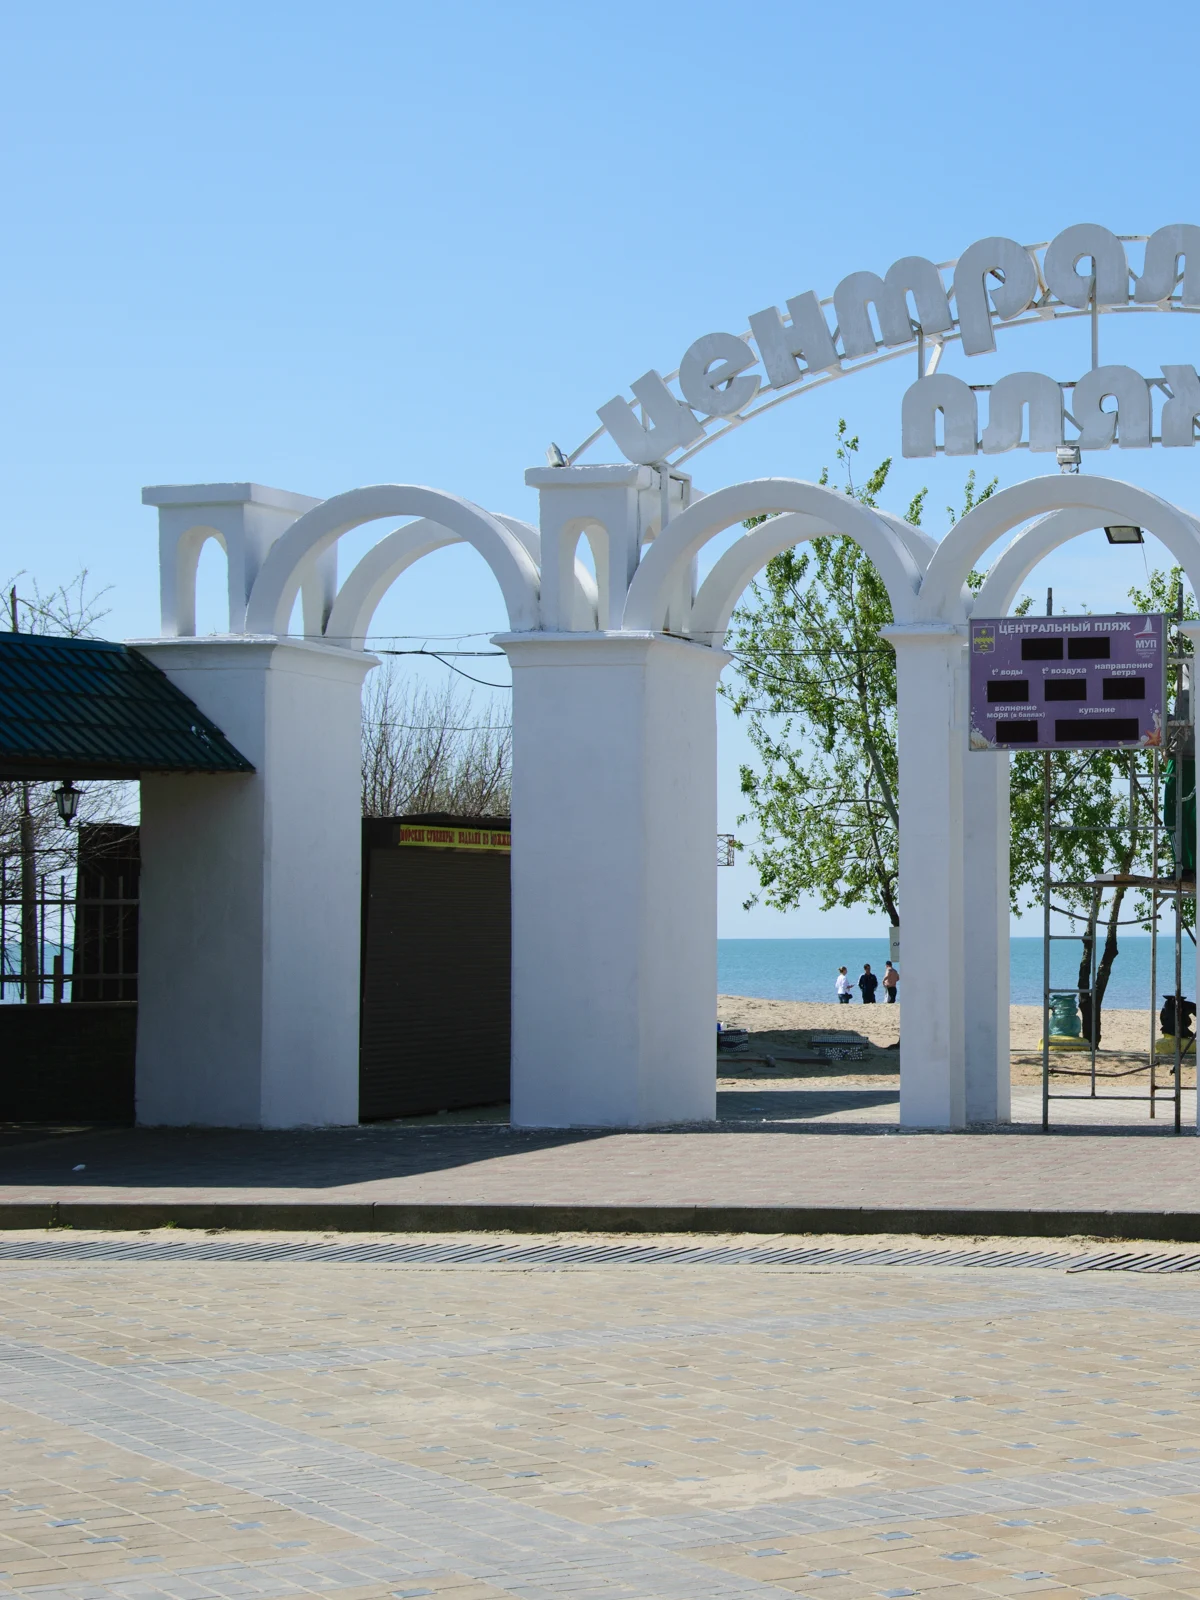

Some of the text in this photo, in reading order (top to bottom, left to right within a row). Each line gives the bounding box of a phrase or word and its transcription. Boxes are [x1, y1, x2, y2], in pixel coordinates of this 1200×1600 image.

[999, 621, 1130, 635] ЦЕНТРАЛЬНЫЙ ПЛЯЖ
[1135, 639, 1156, 649] МУП
[1094, 662, 1153, 670] направление
[1051, 667, 1087, 675] воздуха
[1078, 706, 1115, 714] купание
